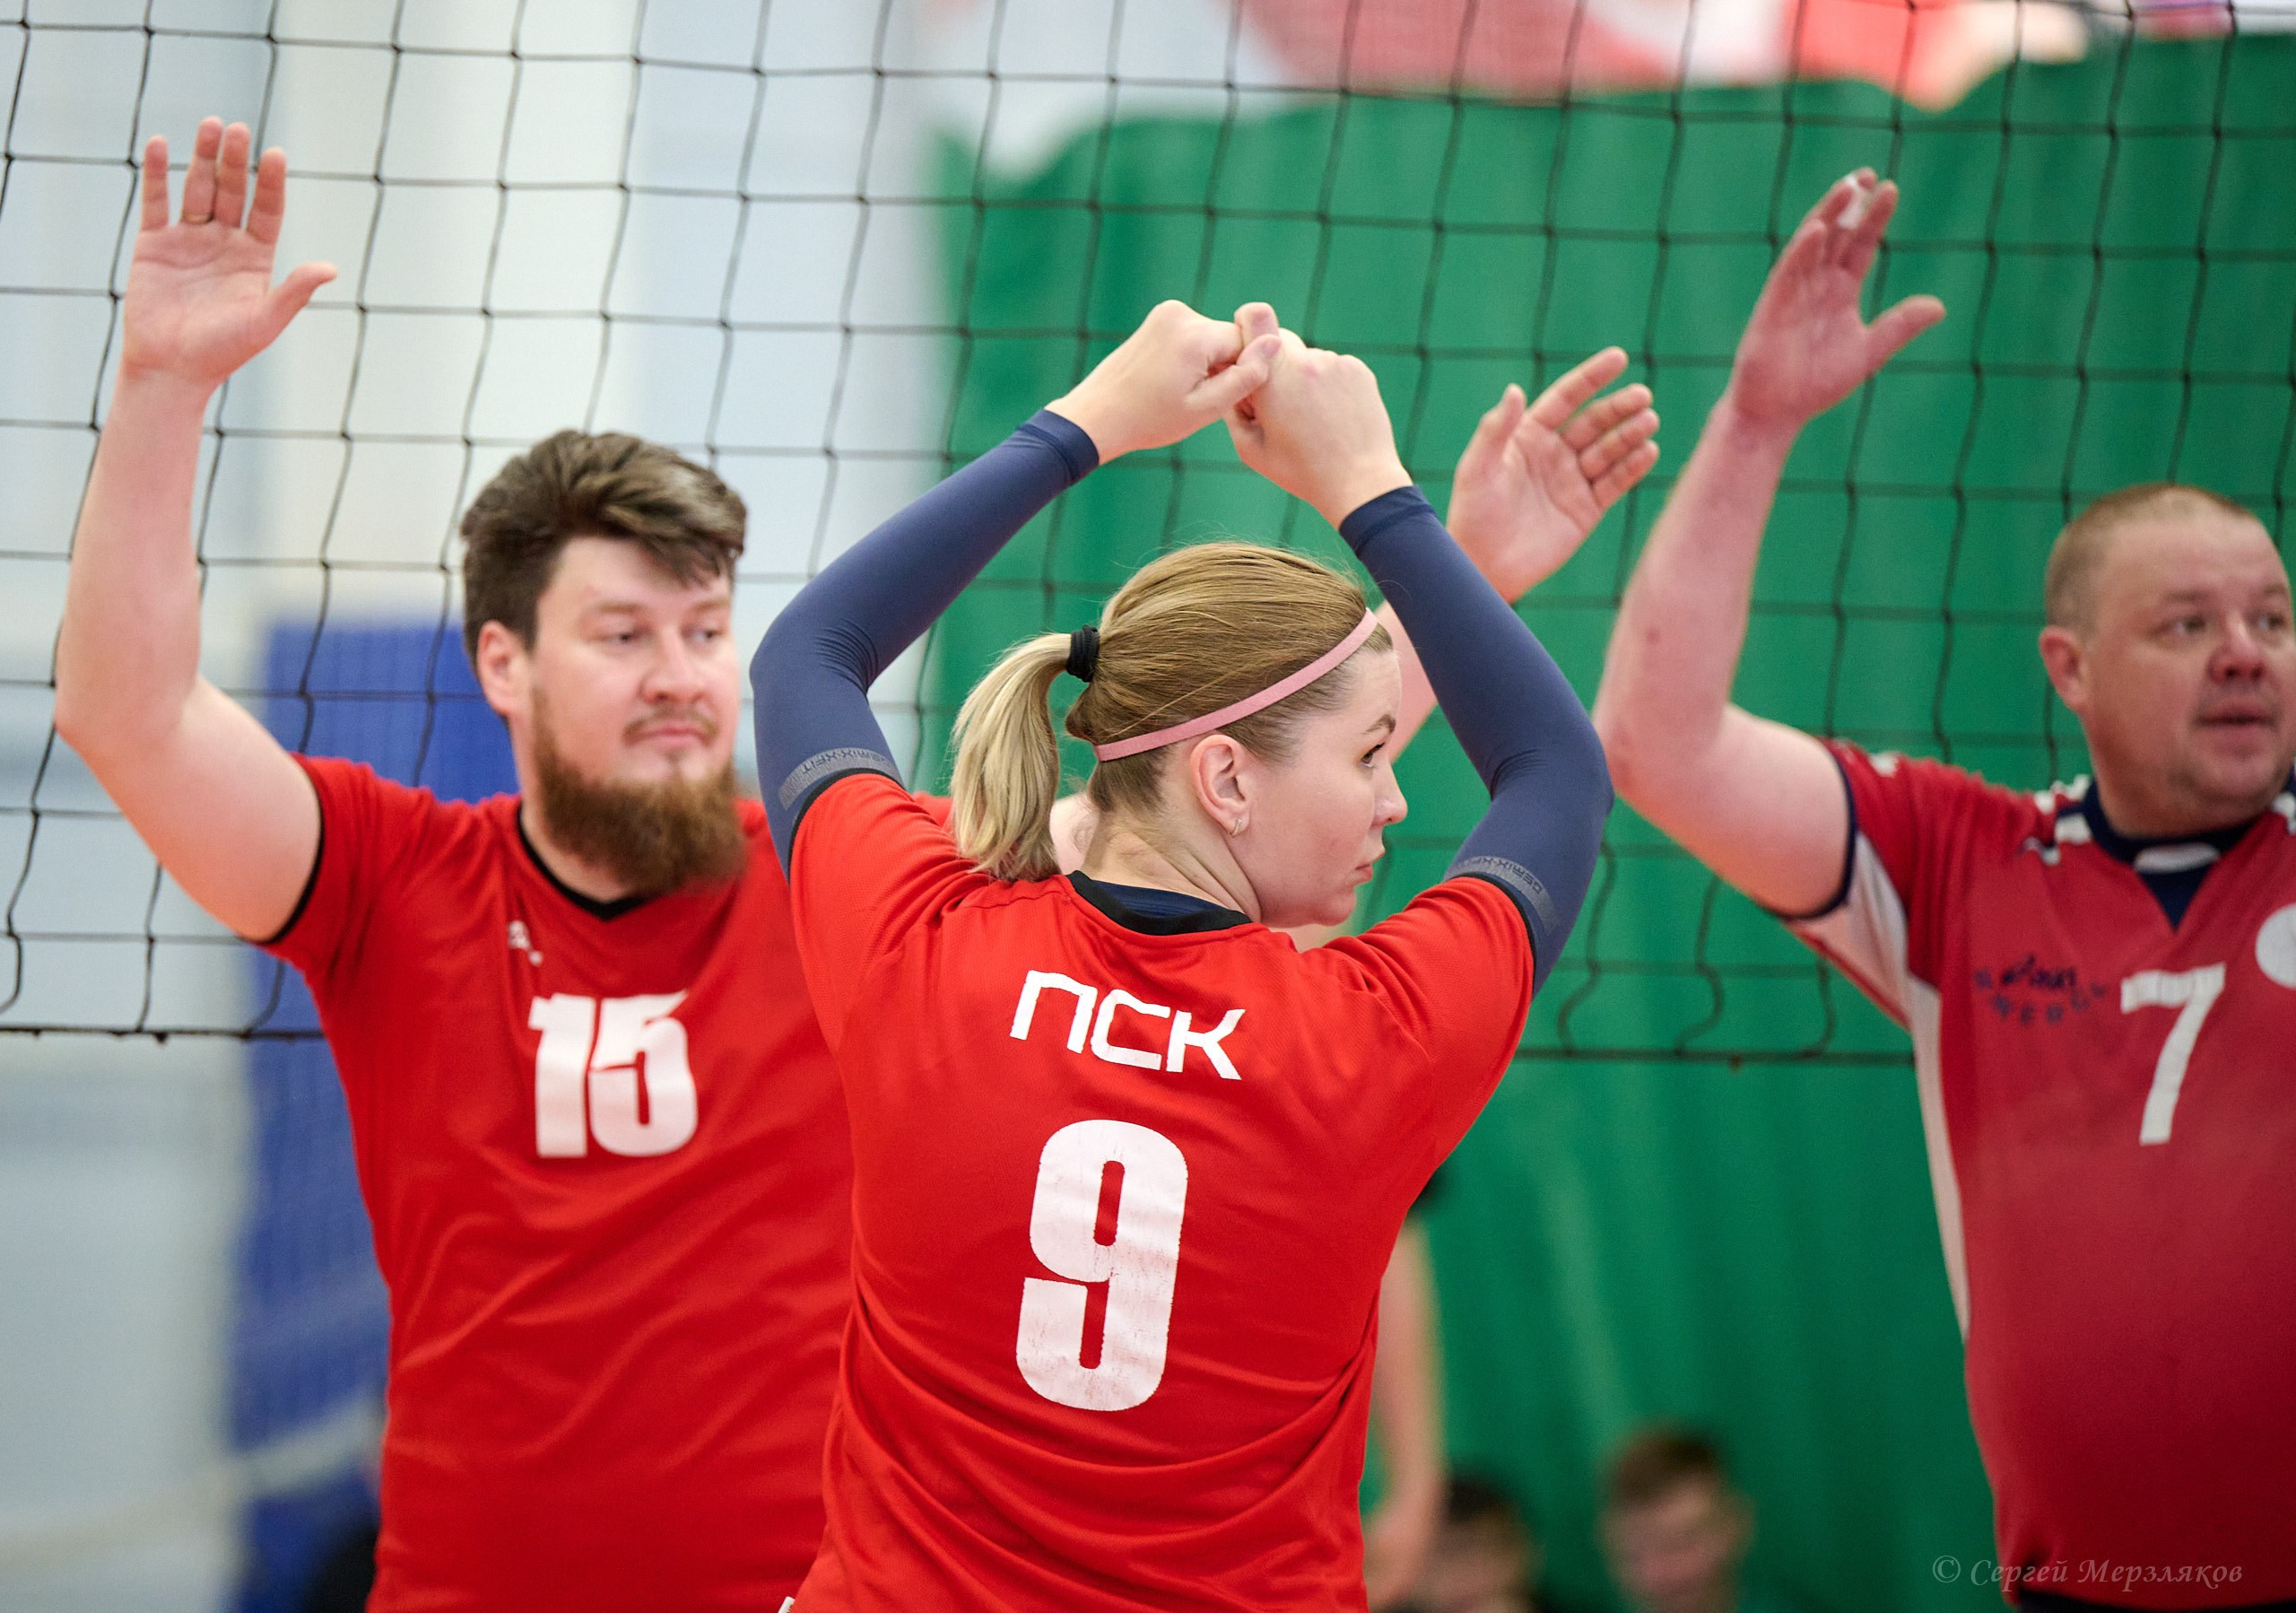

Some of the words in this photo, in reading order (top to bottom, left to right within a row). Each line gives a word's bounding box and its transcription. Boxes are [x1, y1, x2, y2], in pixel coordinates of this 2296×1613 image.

[526, 988, 699, 1159] 15
[2120, 963, 2226, 1145] 7
[1015, 1119, 1188, 1412] 9
